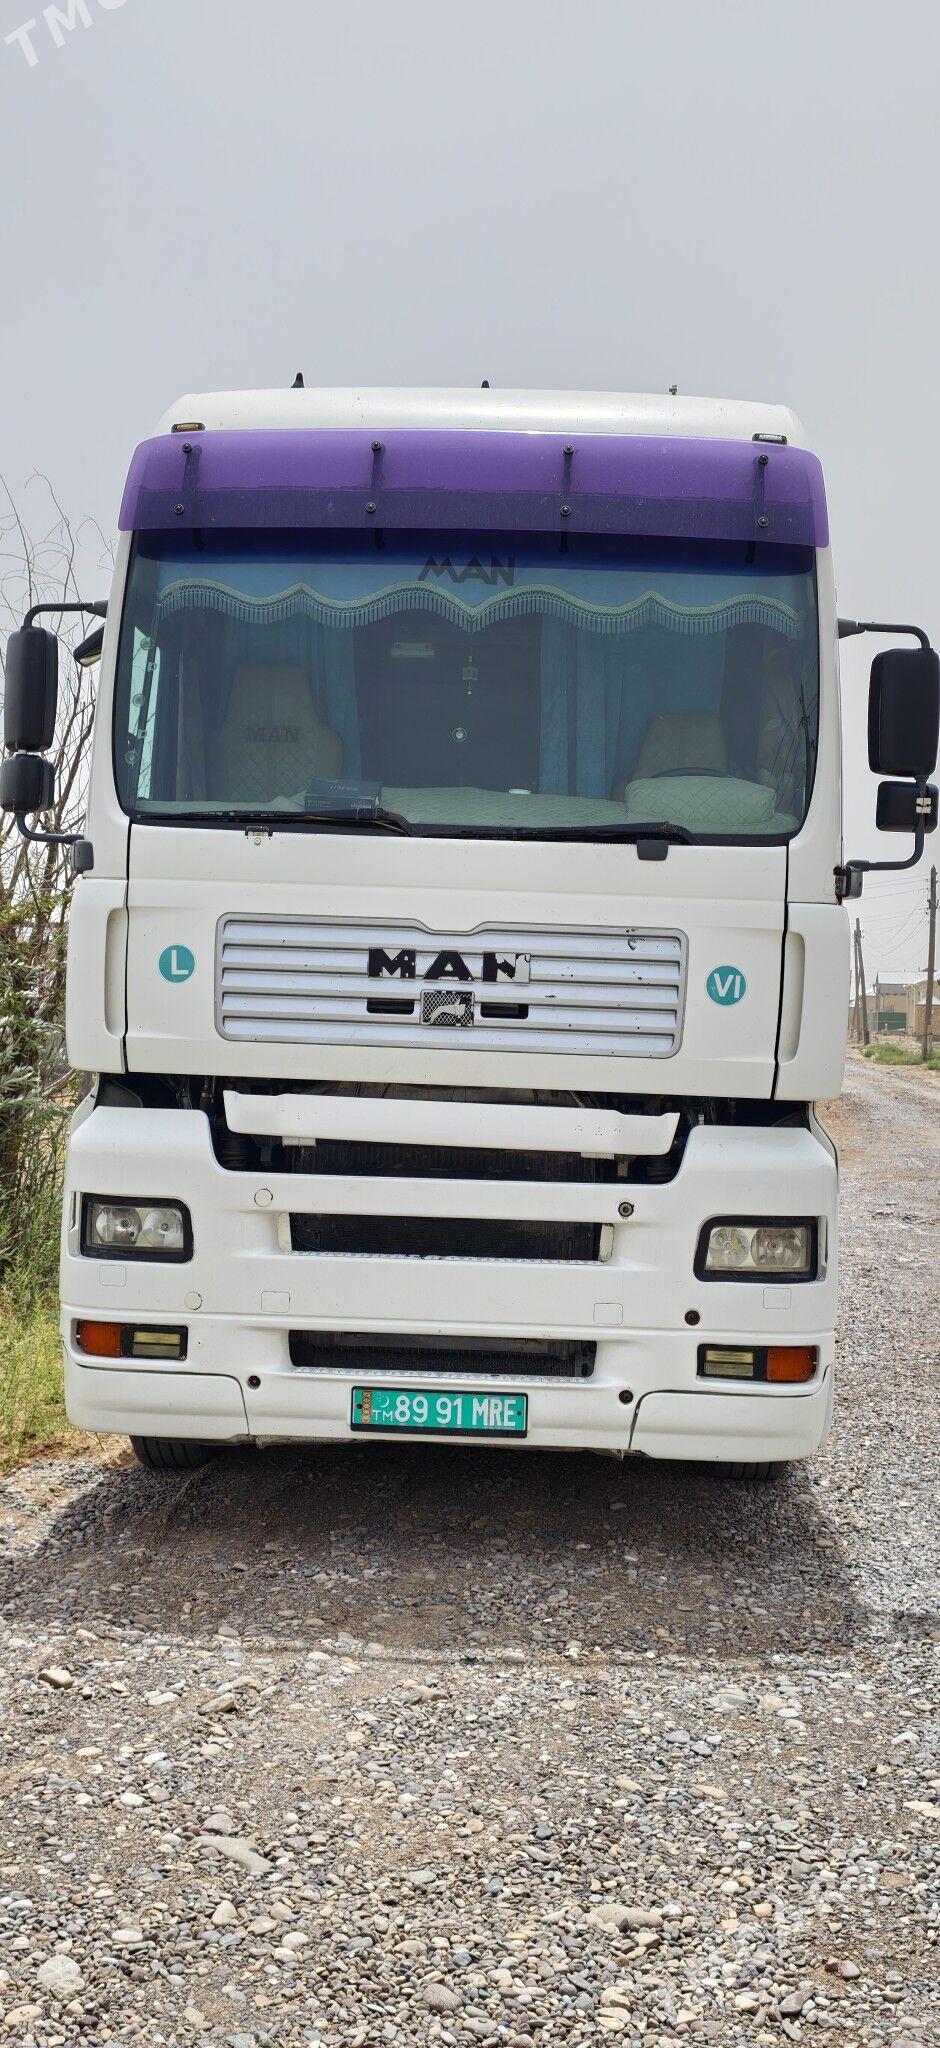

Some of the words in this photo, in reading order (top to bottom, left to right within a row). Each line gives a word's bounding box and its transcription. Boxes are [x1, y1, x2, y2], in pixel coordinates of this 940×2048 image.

[417, 555, 516, 586] MAN
[248, 726, 302, 743] MAN
[171, 949, 190, 975] L
[368, 948, 531, 983] MAN
[713, 973, 741, 999] VI
[372, 1409, 394, 1422] TM
[395, 1395, 429, 1423] 89
[436, 1397, 462, 1425] 91
[471, 1398, 516, 1427] MRE
